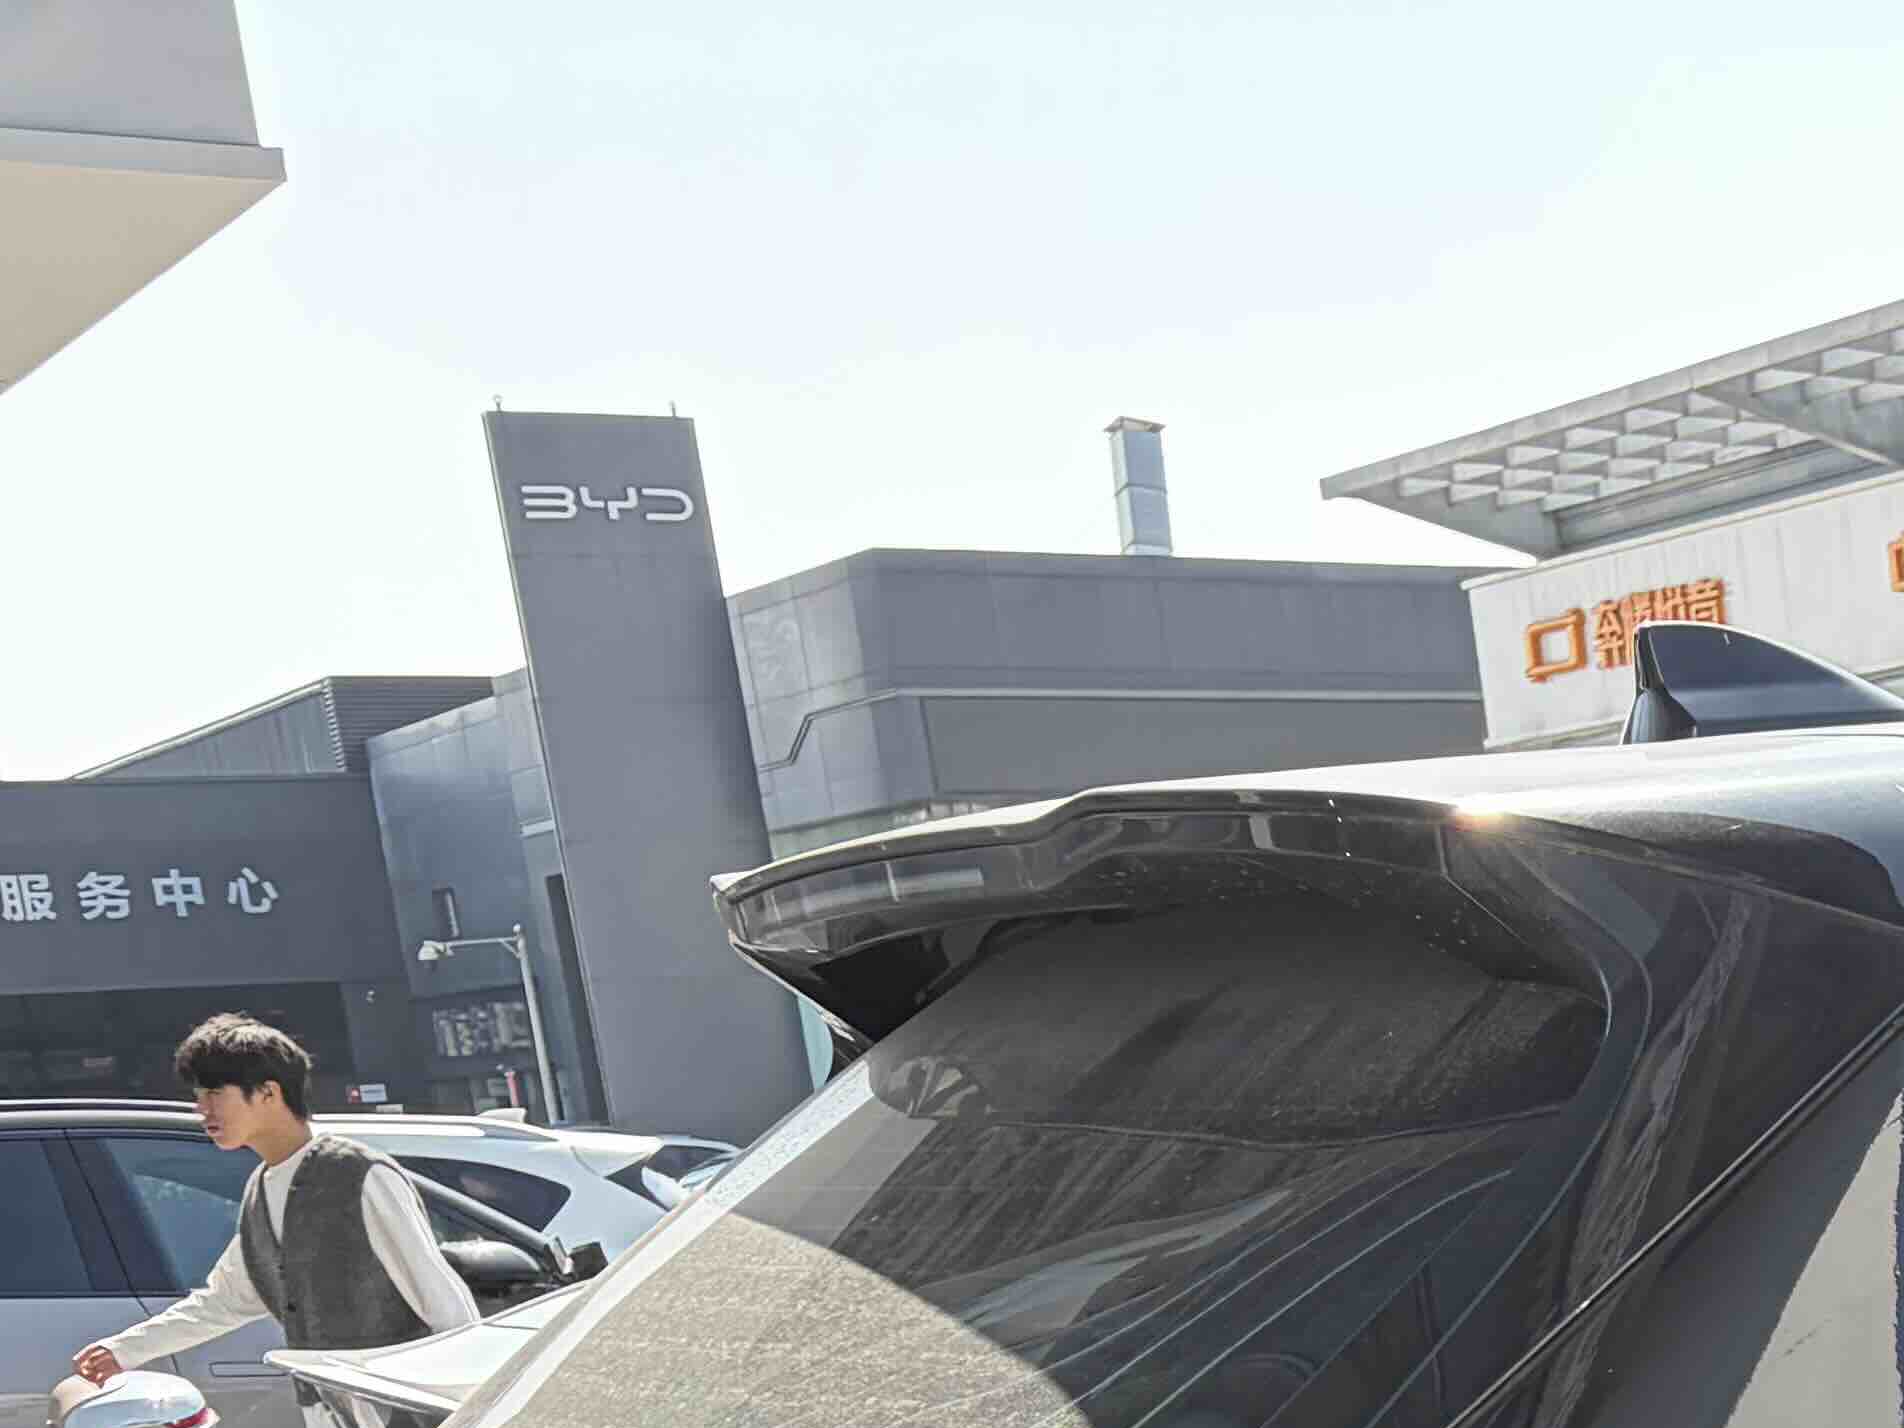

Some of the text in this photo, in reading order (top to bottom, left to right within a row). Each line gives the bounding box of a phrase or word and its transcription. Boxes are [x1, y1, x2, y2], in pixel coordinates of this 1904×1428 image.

[520, 485, 695, 522] BYD
[0, 867, 279, 921] 服务中心
